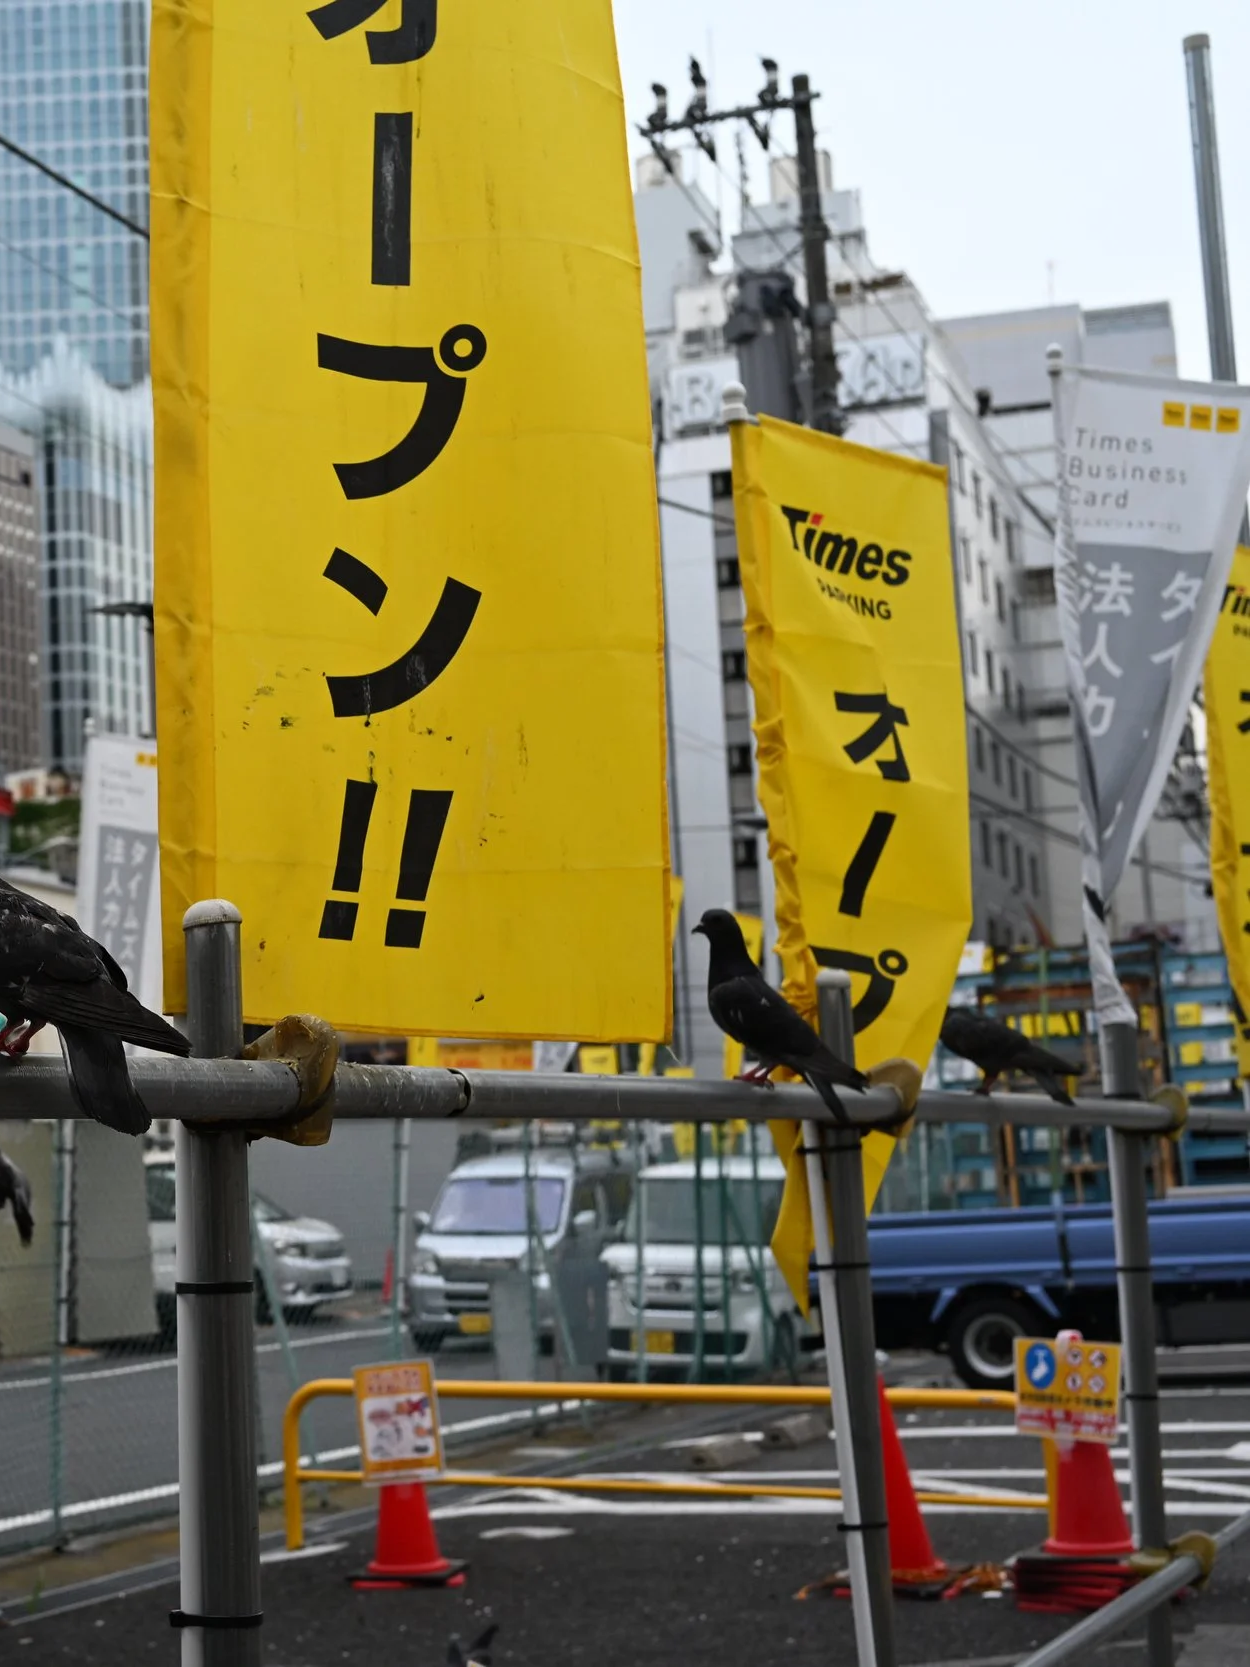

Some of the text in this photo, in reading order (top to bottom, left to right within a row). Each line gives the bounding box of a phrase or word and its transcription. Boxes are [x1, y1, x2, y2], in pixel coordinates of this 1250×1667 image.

[1075, 427, 1154, 454] Times
[1067, 456, 1188, 485] Business
[1065, 484, 1129, 509] Card
[780, 505, 912, 587] Times
